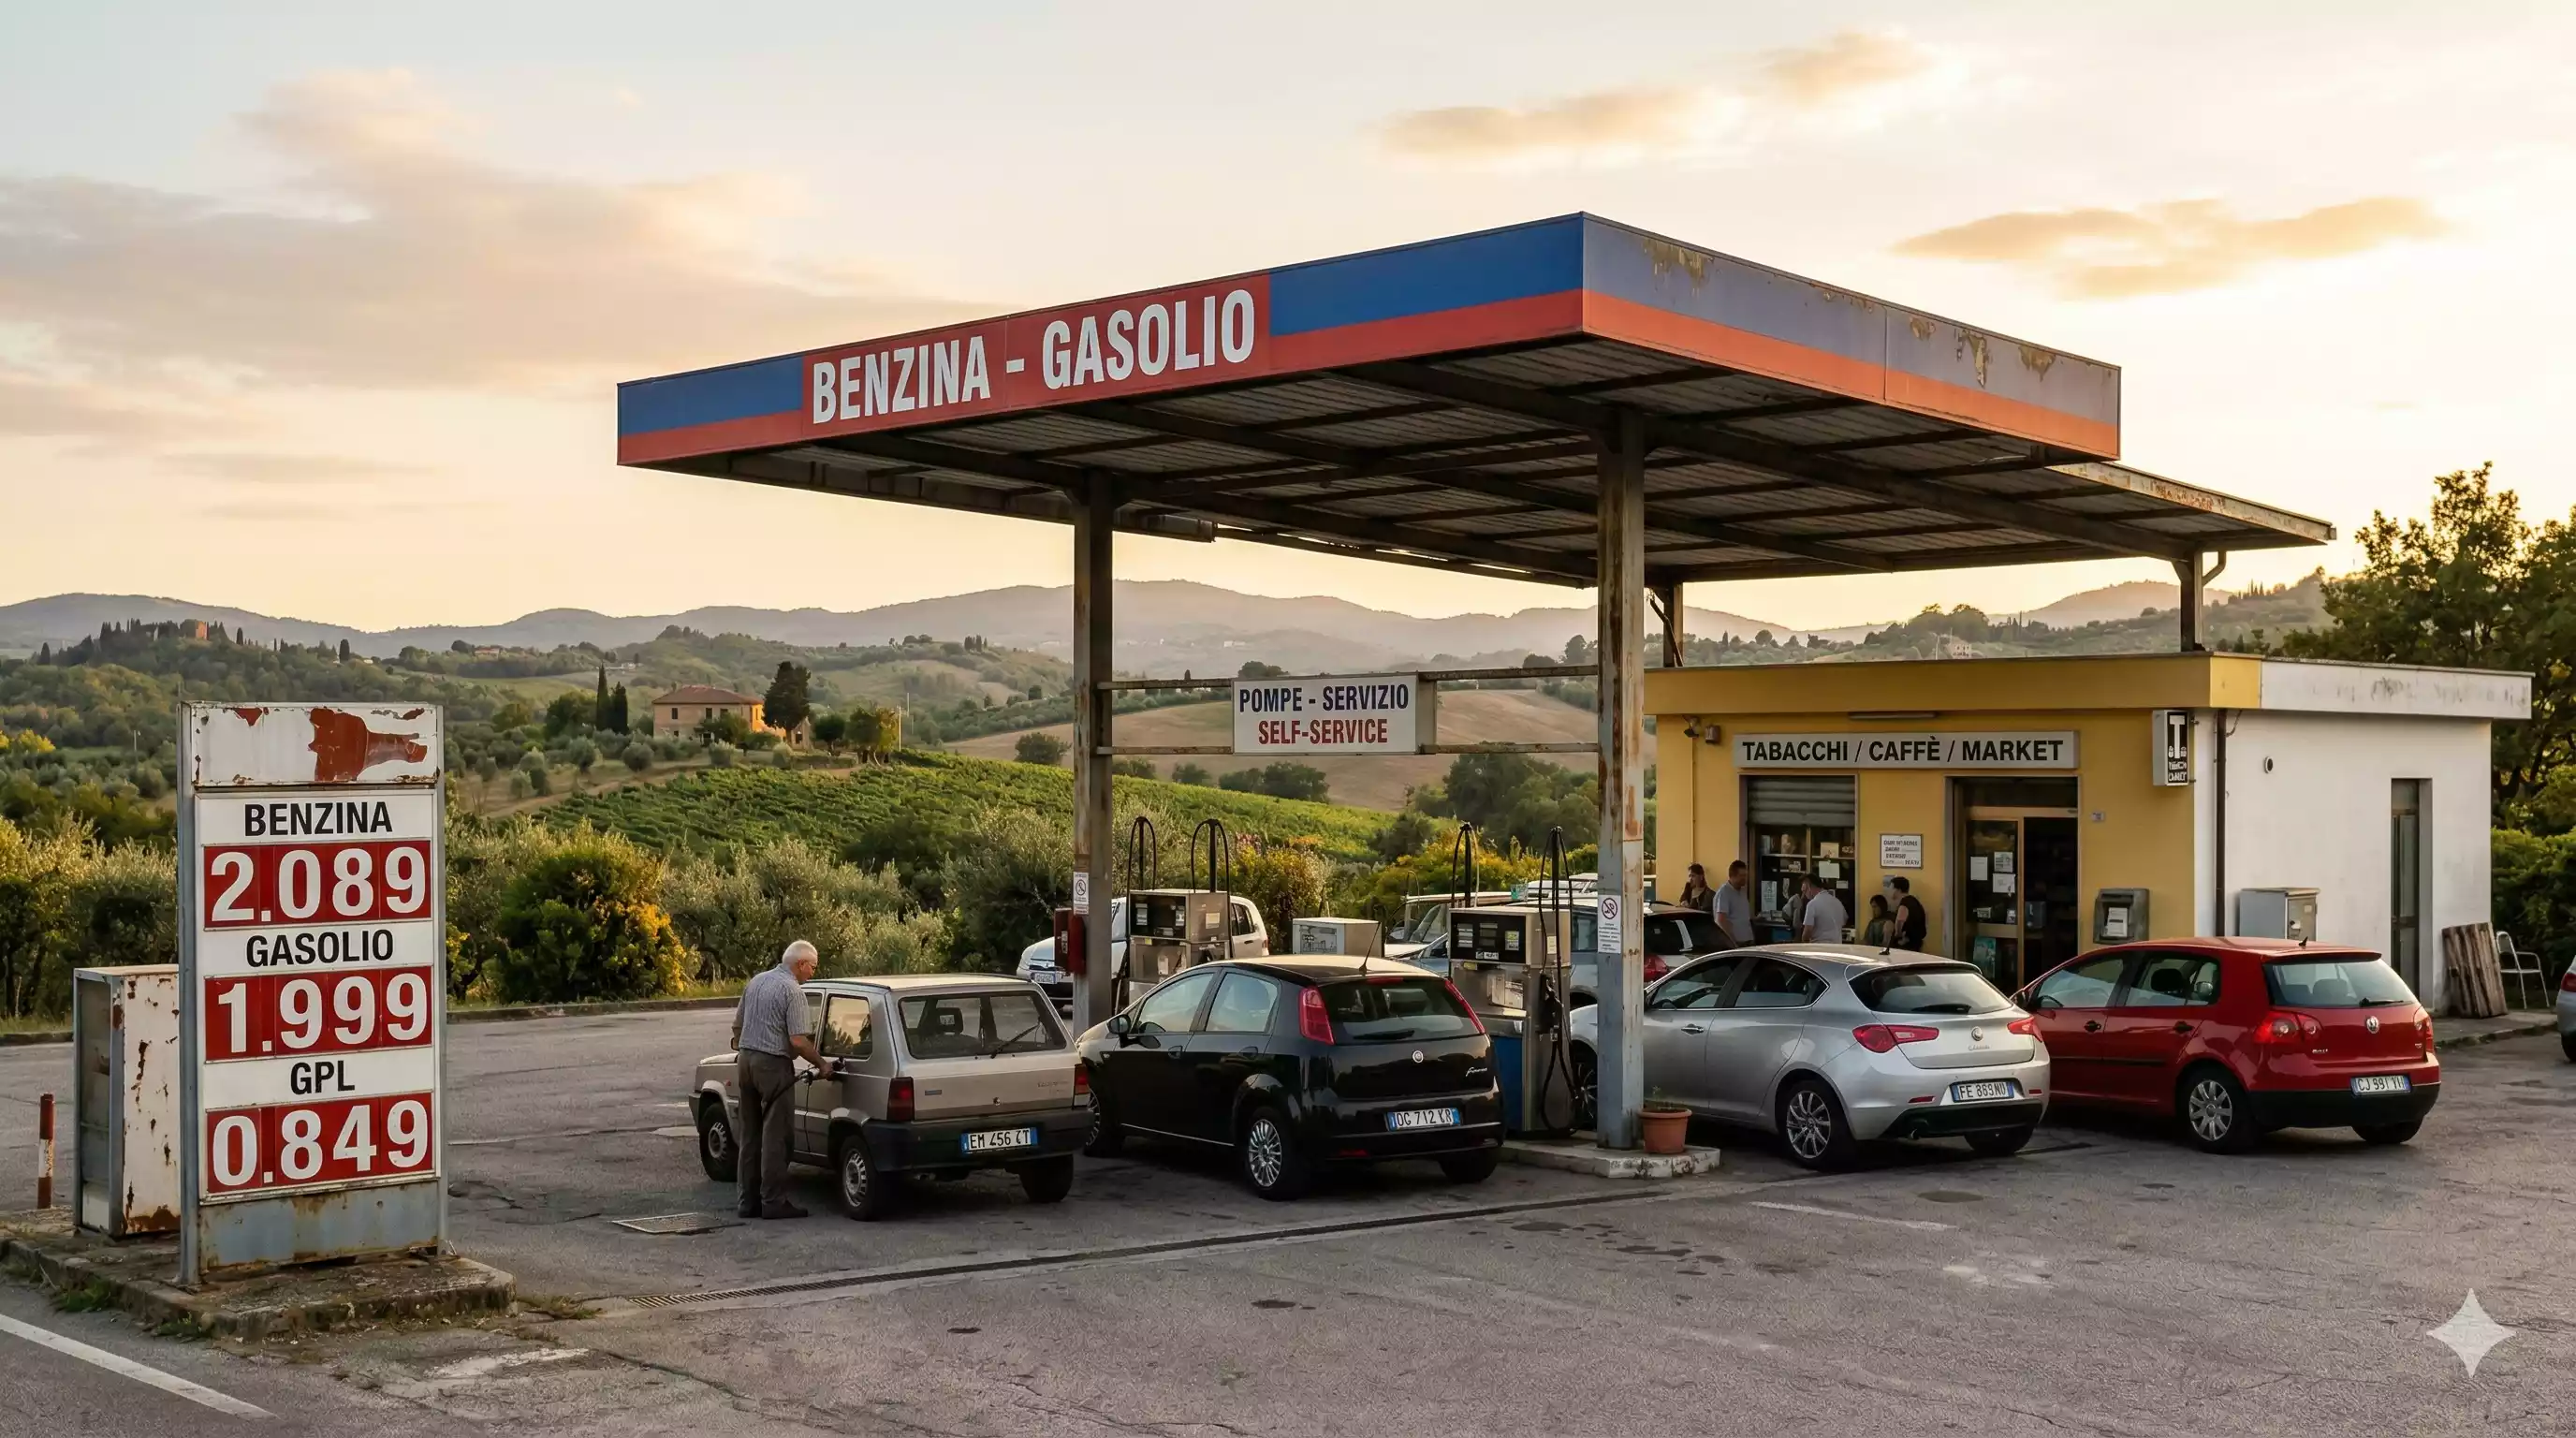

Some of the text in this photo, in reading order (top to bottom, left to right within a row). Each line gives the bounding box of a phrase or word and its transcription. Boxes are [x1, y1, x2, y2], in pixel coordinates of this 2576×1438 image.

[812, 288, 1255, 425] BENZINA - GASOLIO
[1239, 687, 1303, 713] POMPE
[1322, 683, 1409, 712] SERVIZIO
[1258, 718, 1388, 745] SELF-SERVICE
[1741, 735, 2064, 763] TABACCHI / CAFFÈ / MARKET
[244, 801, 393, 837] BENZINA
[211, 846, 426, 922] 2.089
[246, 929, 393, 968] GASOLIO
[218, 973, 428, 1053] 1.999
[290, 1060, 356, 1095] GPL
[1959, 1085, 1973, 1098] FE
[1414, 1110, 1436, 1124] 712
[212, 1099, 428, 1186] 0.849
[970, 1134, 985, 1149] EM
[989, 1131, 1011, 1146] 456
